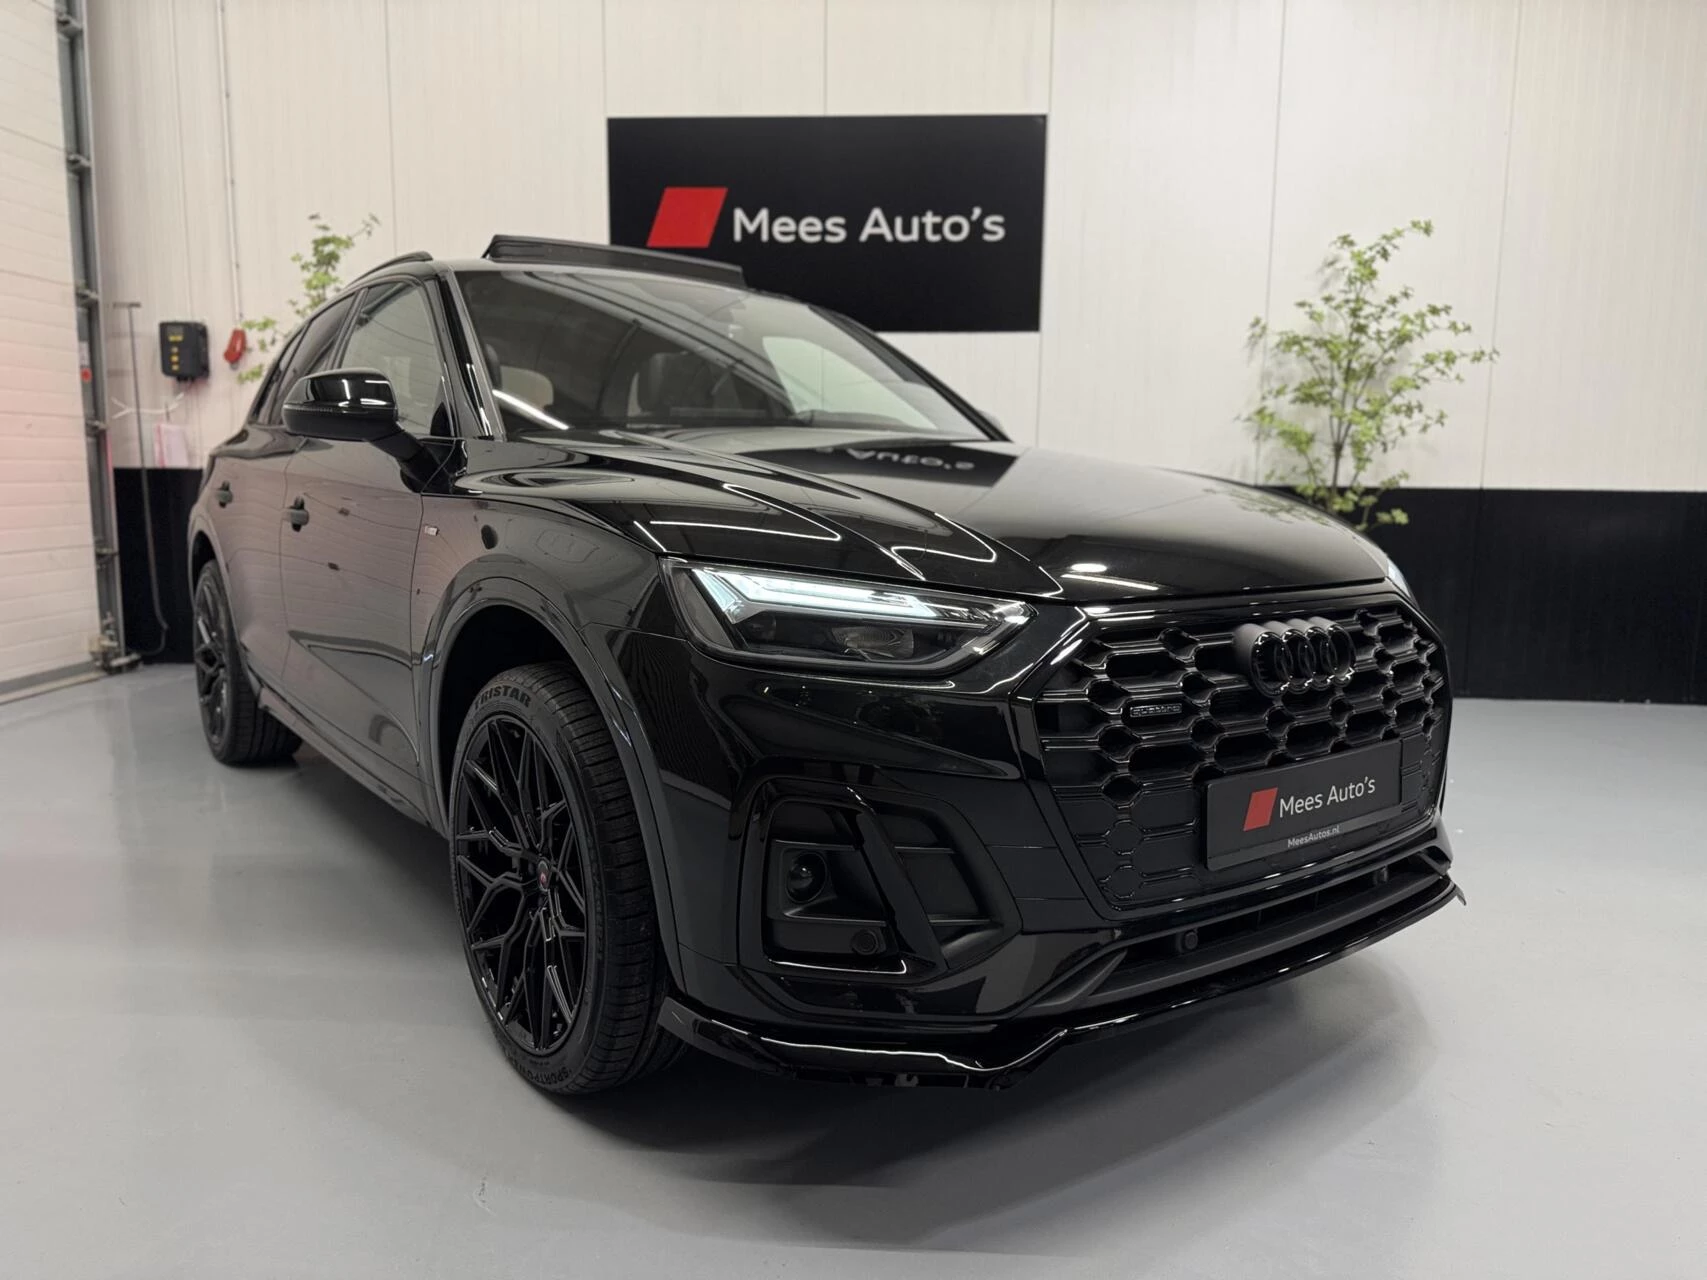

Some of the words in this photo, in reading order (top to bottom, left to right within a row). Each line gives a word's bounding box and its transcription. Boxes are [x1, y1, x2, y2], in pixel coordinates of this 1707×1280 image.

[733, 207, 847, 243] Mees
[859, 206, 1006, 243] Auto’s
[1279, 794, 1323, 818] Mees
[1326, 776, 1376, 805] Auto’s
[1287, 824, 1341, 848] MeesAutos.nl
